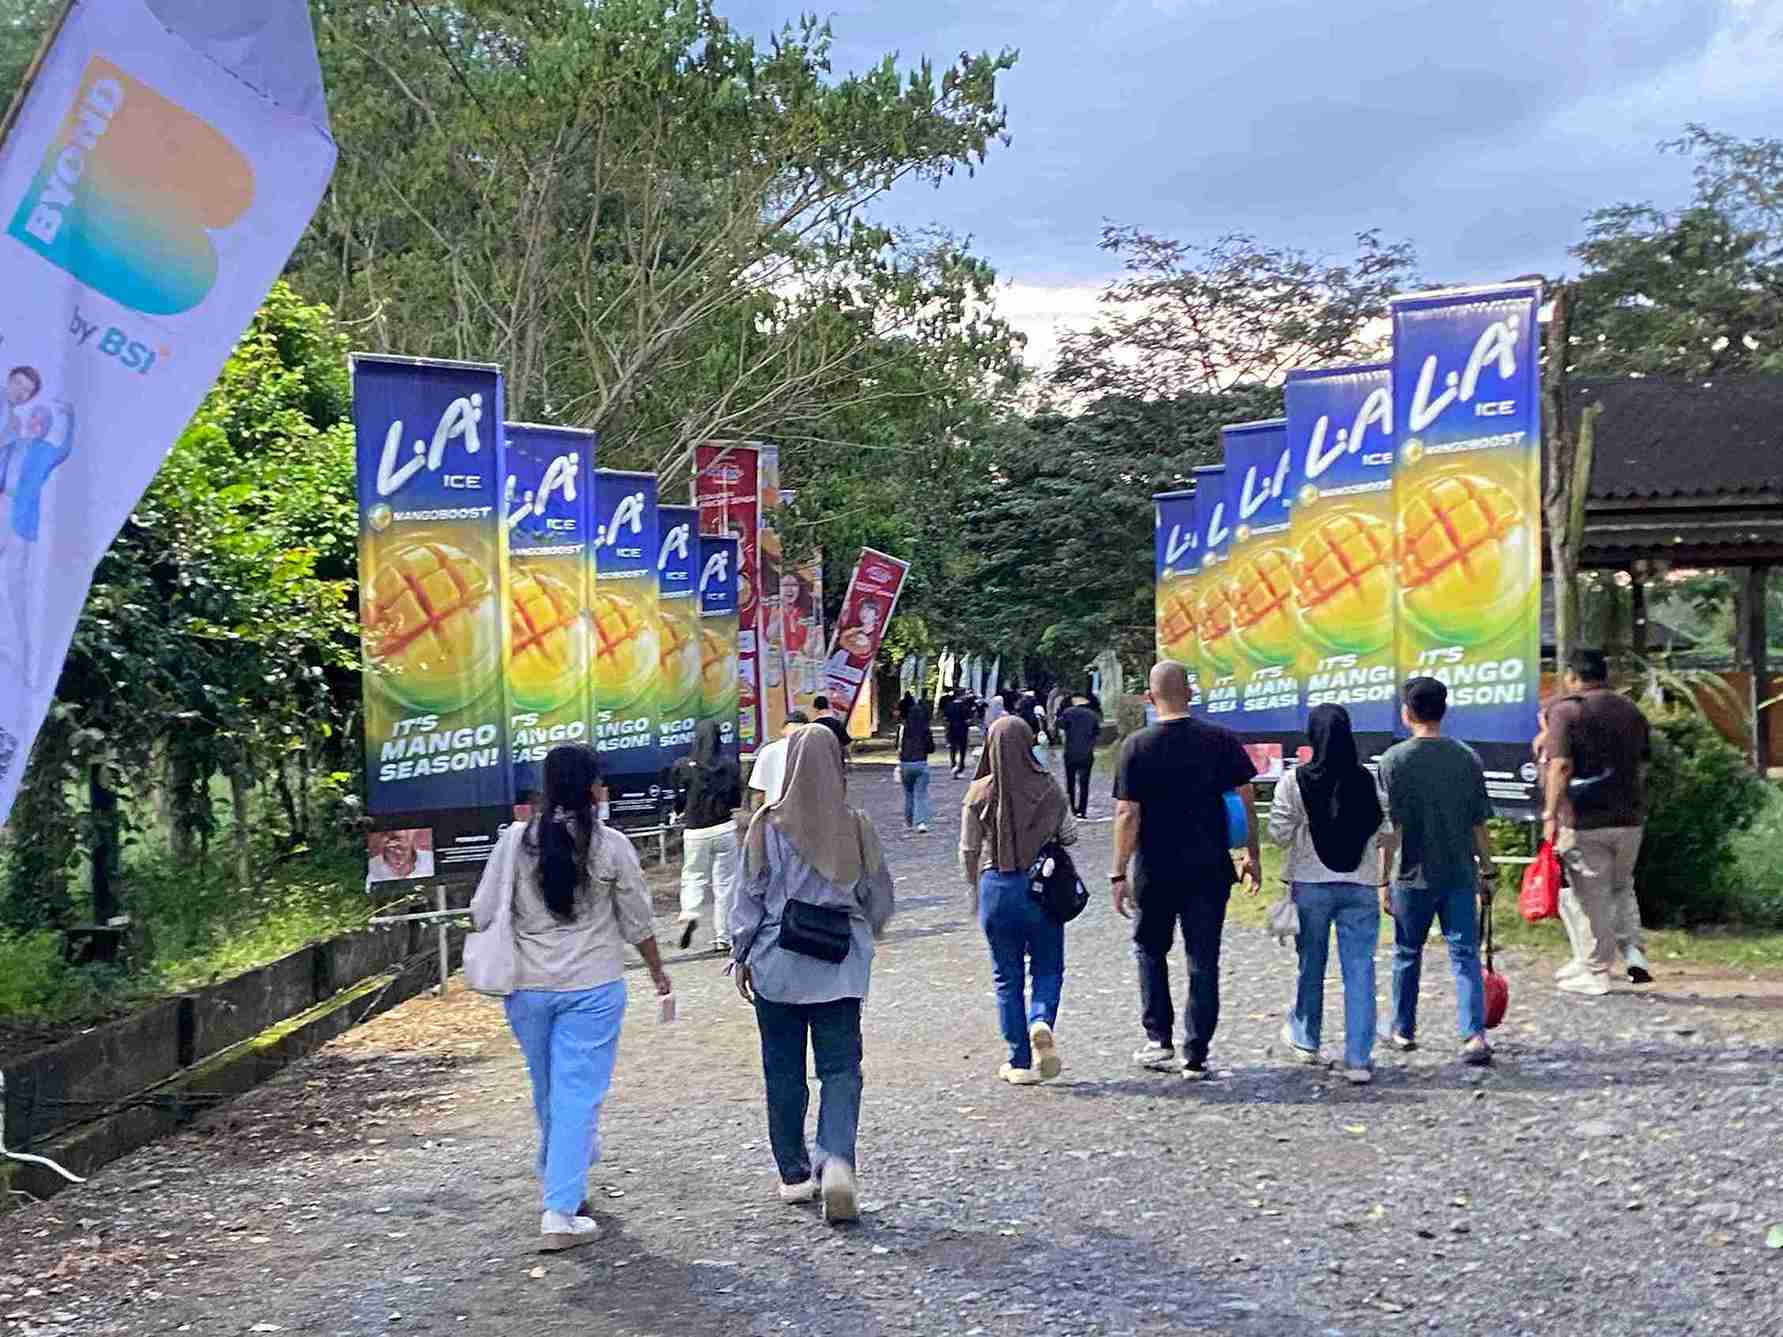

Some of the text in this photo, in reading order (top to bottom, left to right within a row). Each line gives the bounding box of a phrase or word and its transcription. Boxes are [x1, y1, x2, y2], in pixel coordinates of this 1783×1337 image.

[69, 307, 97, 346] by
[1475, 401, 1516, 416] ICE
[443, 474, 482, 489] ICE
[393, 506, 492, 521] MANGOBOOST
[1308, 665, 1394, 693] MANG
[380, 724, 498, 762] MANGO
[512, 721, 585, 746] ANGO
[379, 747, 500, 782] SEASON!
